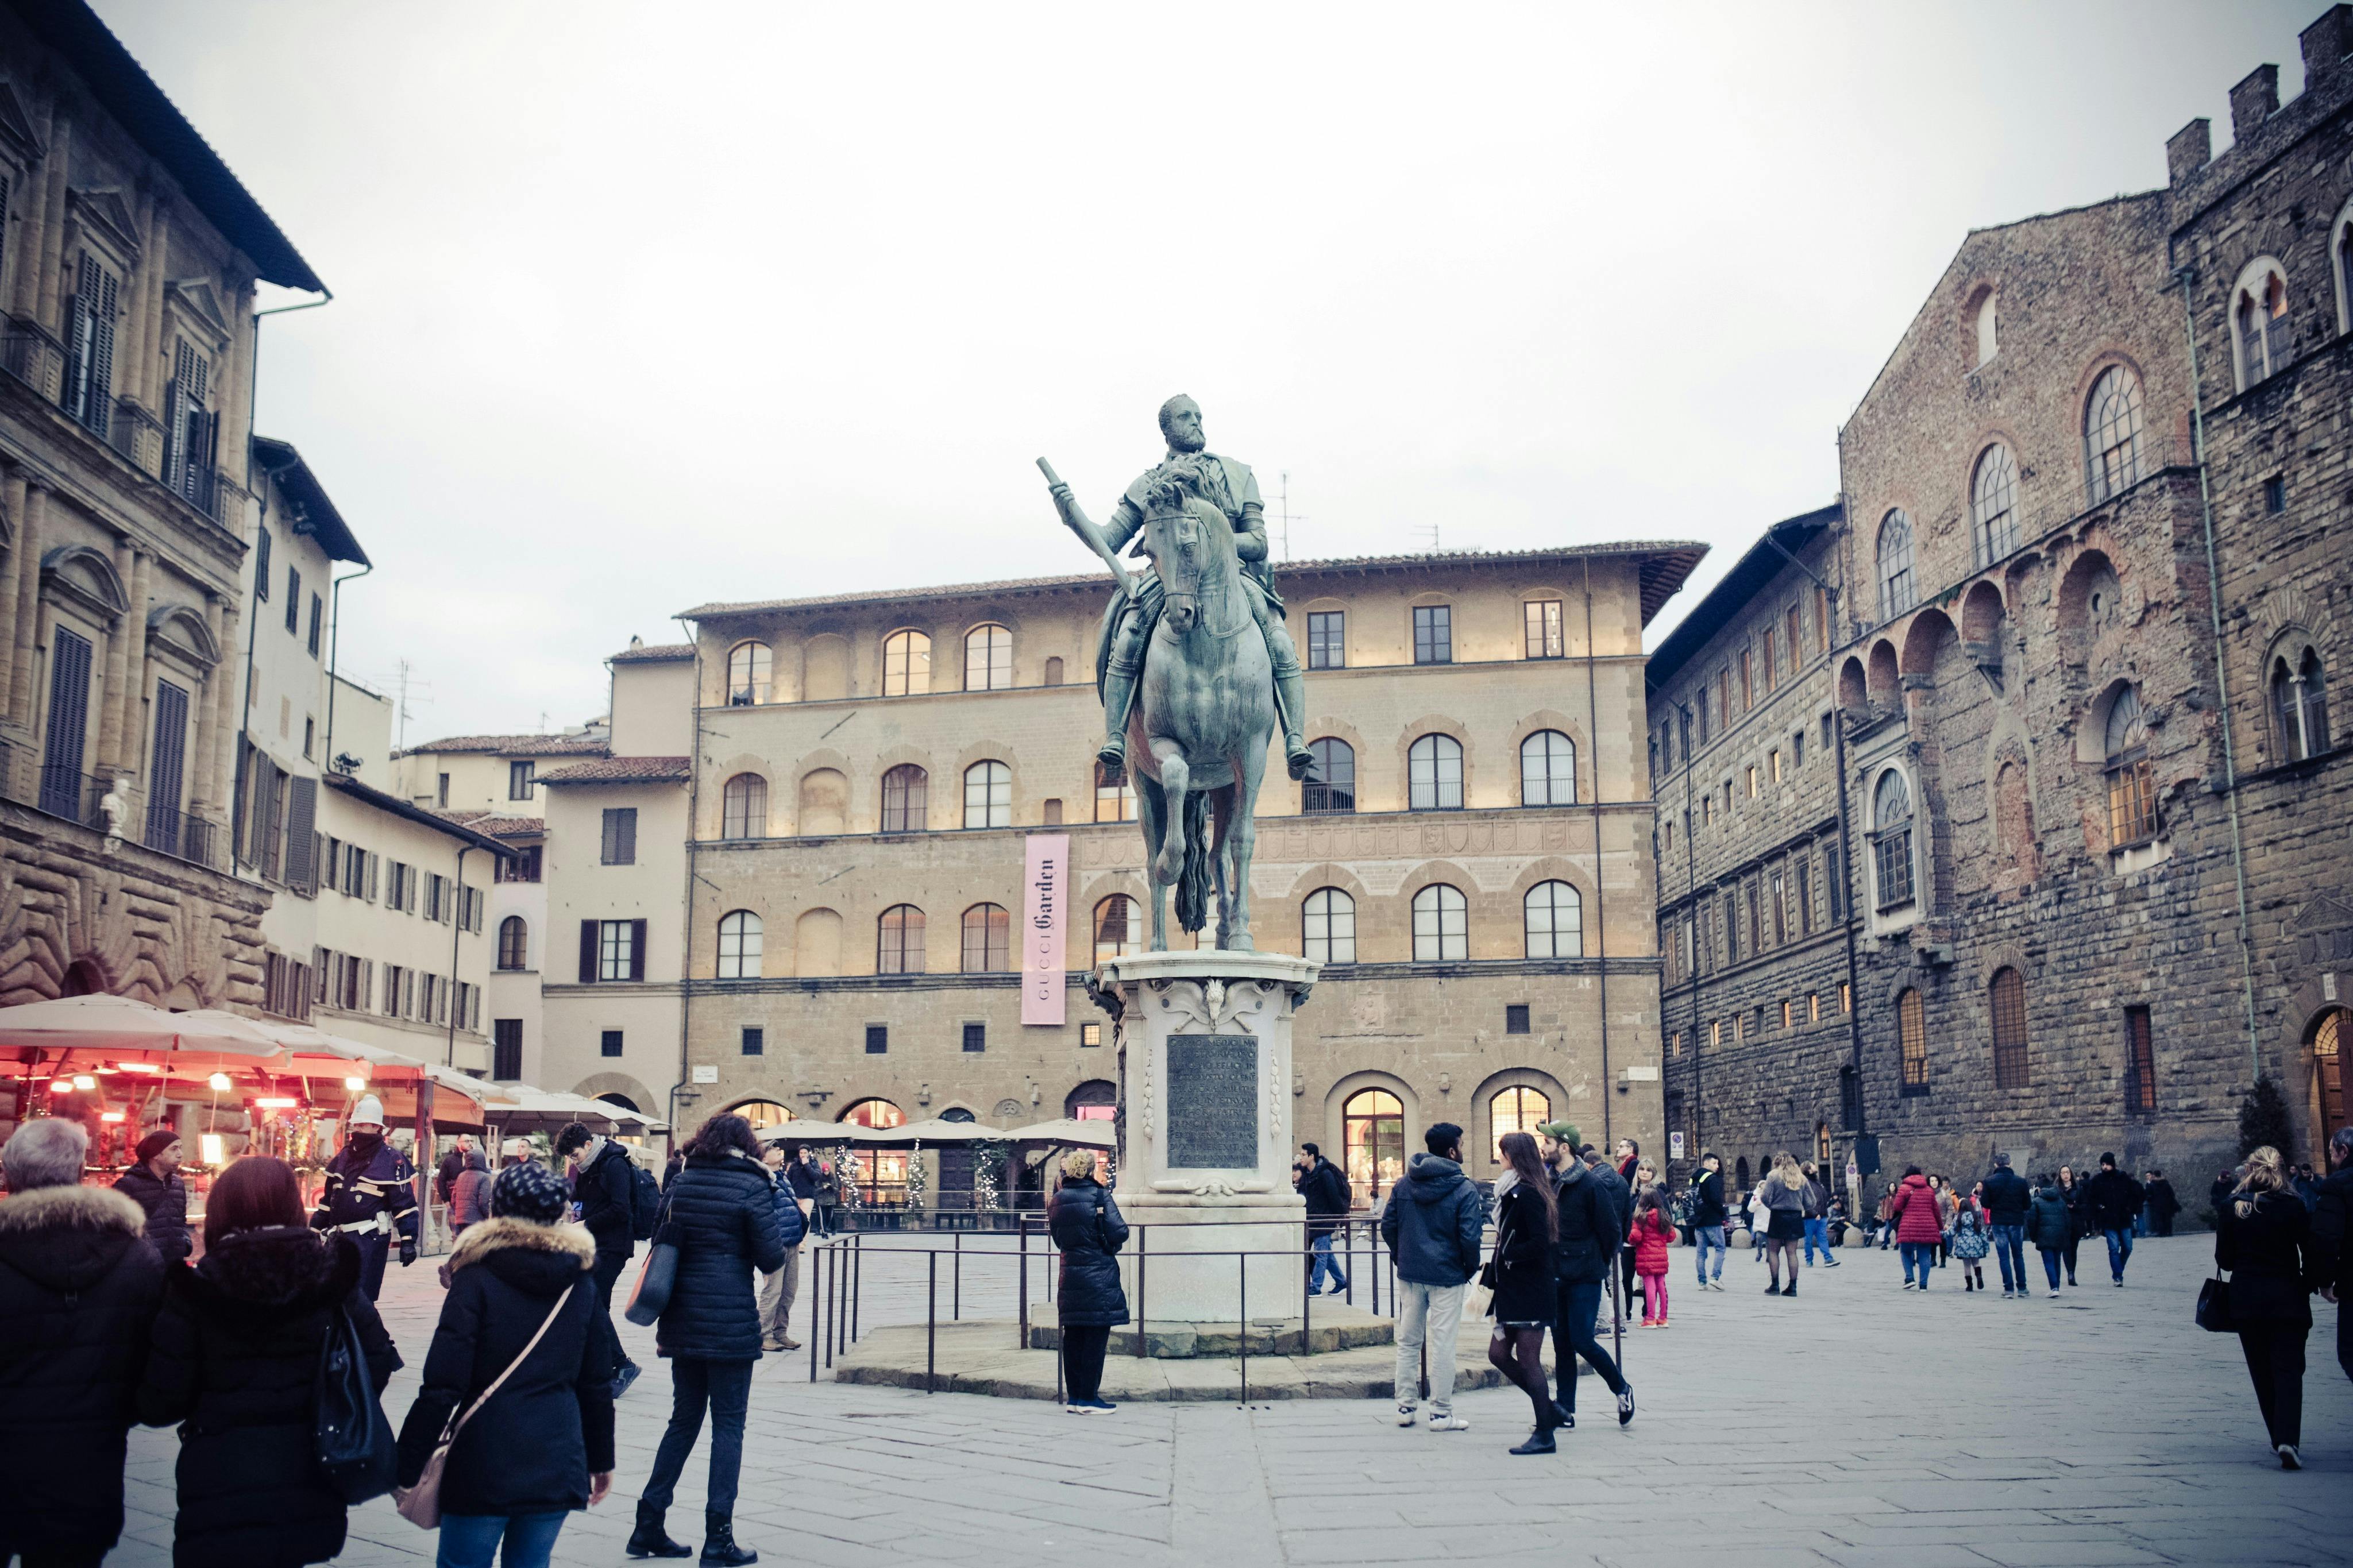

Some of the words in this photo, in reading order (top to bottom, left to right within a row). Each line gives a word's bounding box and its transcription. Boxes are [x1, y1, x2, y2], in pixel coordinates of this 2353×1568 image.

[1033, 860, 1056, 929] Garden
[1039, 935, 1051, 1000] GUCCI
[1246, 1062, 1255, 1070] IN
